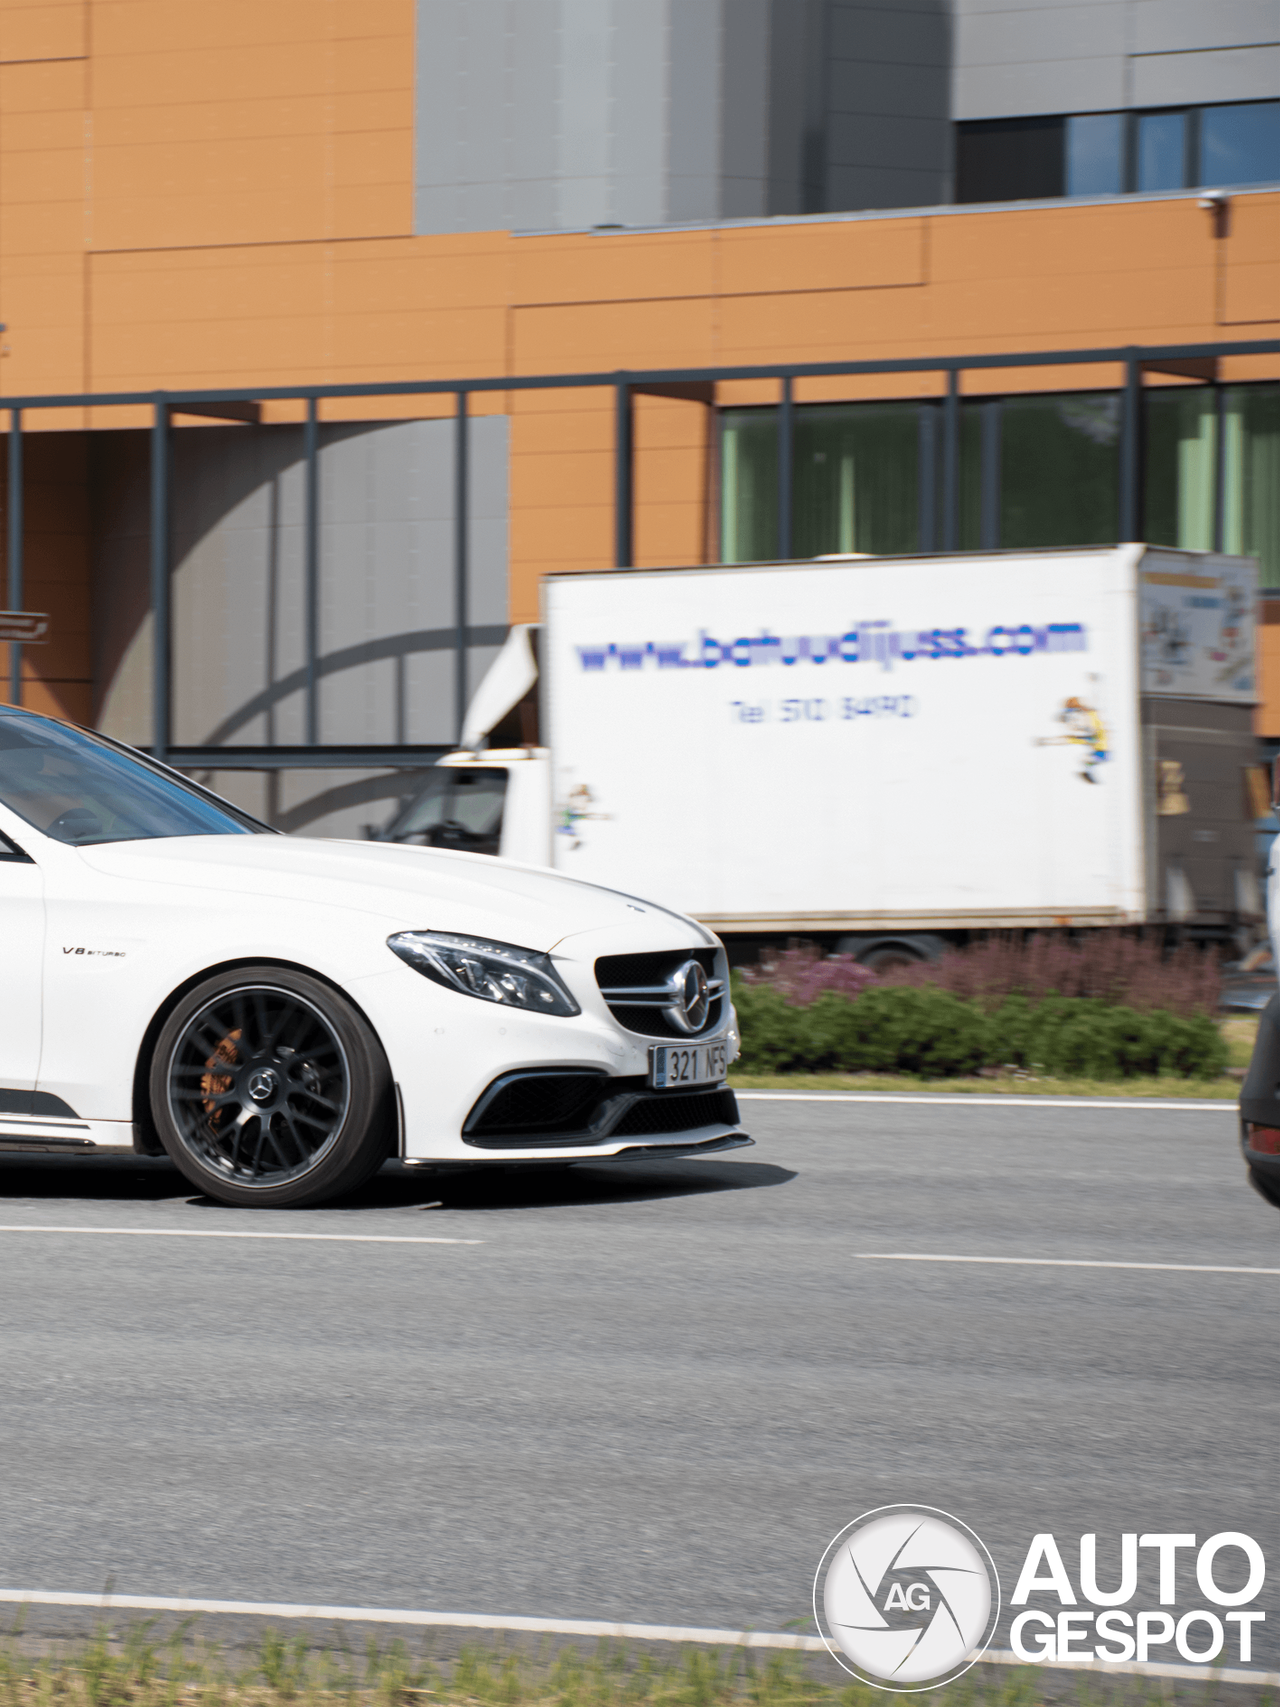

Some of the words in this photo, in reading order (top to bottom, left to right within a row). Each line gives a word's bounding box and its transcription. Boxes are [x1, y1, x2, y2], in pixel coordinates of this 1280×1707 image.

[63, 947, 85, 955] V8
[670, 1049, 698, 1082] 321
[706, 1045, 726, 1078] NFS
